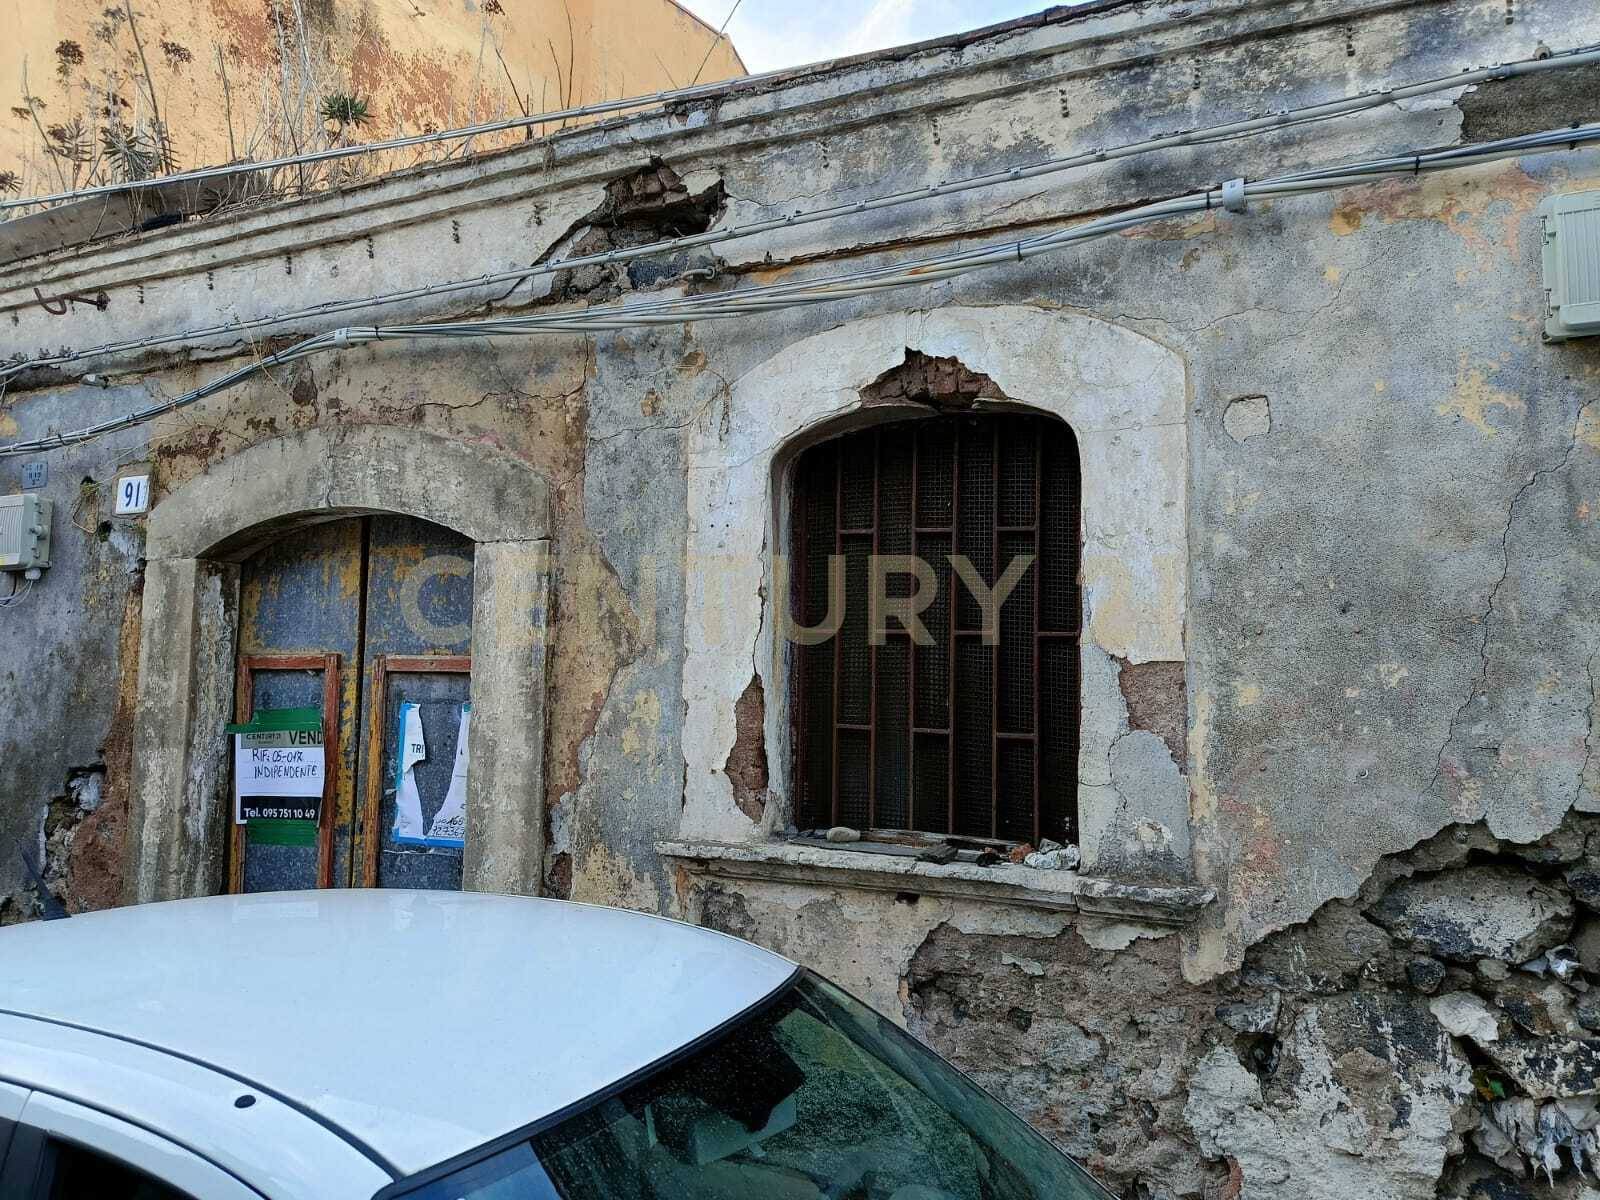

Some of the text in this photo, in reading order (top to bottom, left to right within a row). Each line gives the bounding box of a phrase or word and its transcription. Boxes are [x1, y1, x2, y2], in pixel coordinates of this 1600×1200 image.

[125, 482, 141, 508] 91
[254, 764, 318, 779] INDIPENDENTE
[243, 807, 316, 818] Tel. 095 751 10 49
